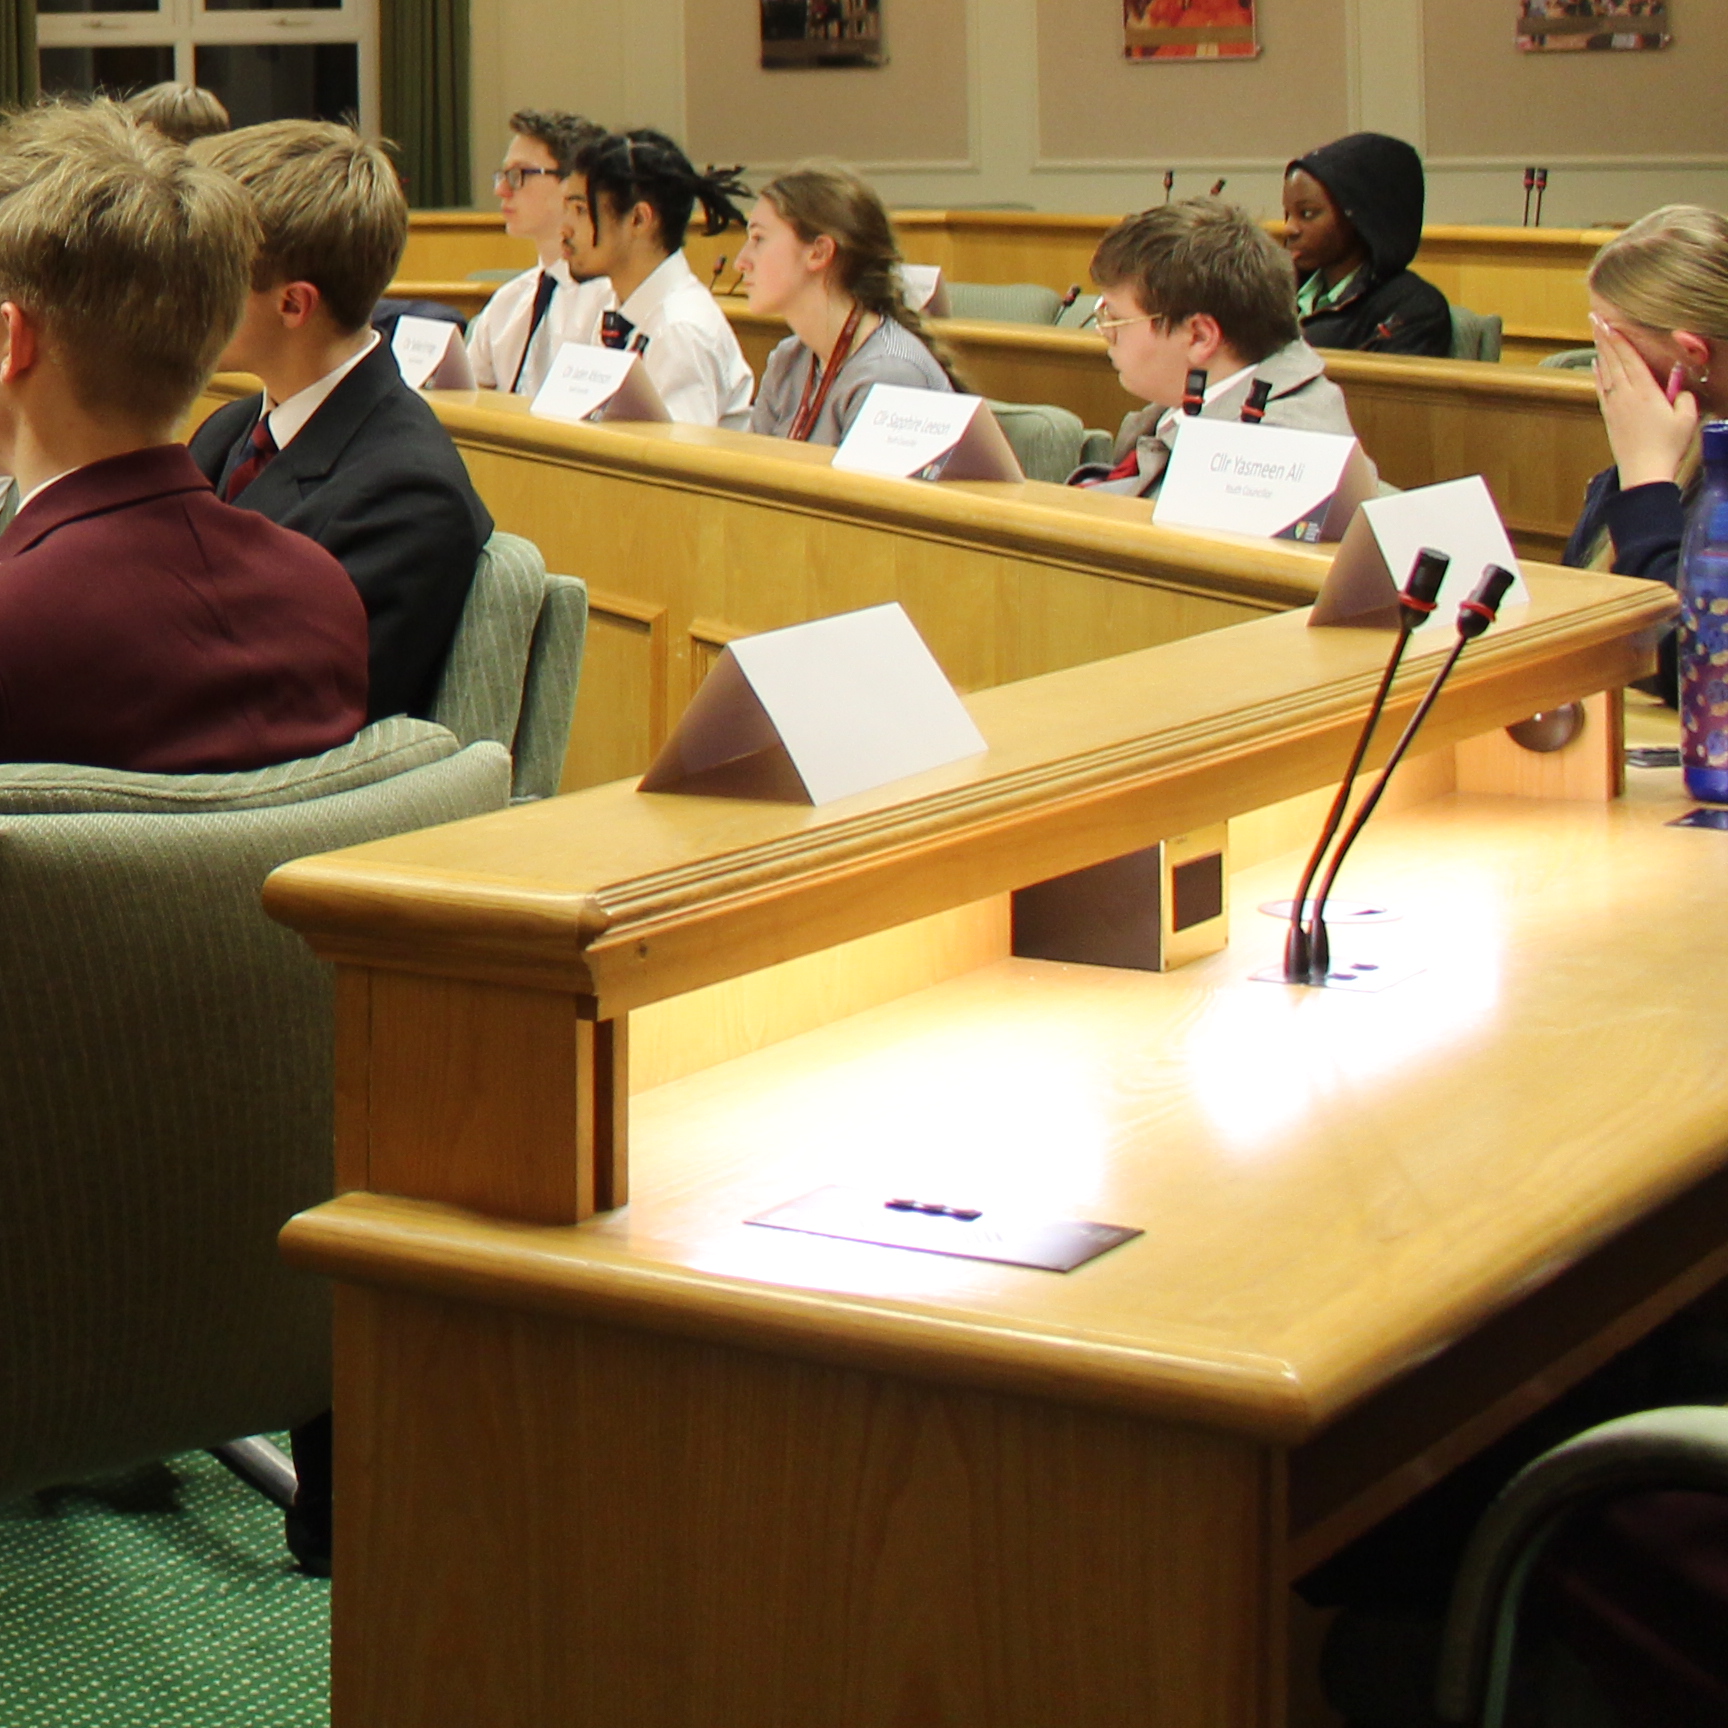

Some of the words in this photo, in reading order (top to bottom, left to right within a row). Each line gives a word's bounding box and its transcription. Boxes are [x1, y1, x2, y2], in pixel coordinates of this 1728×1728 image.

[1211, 453, 1232, 472] Cllr
[1234, 455, 1285, 479] Yasmeen
[1286, 462, 1305, 482] Ali
